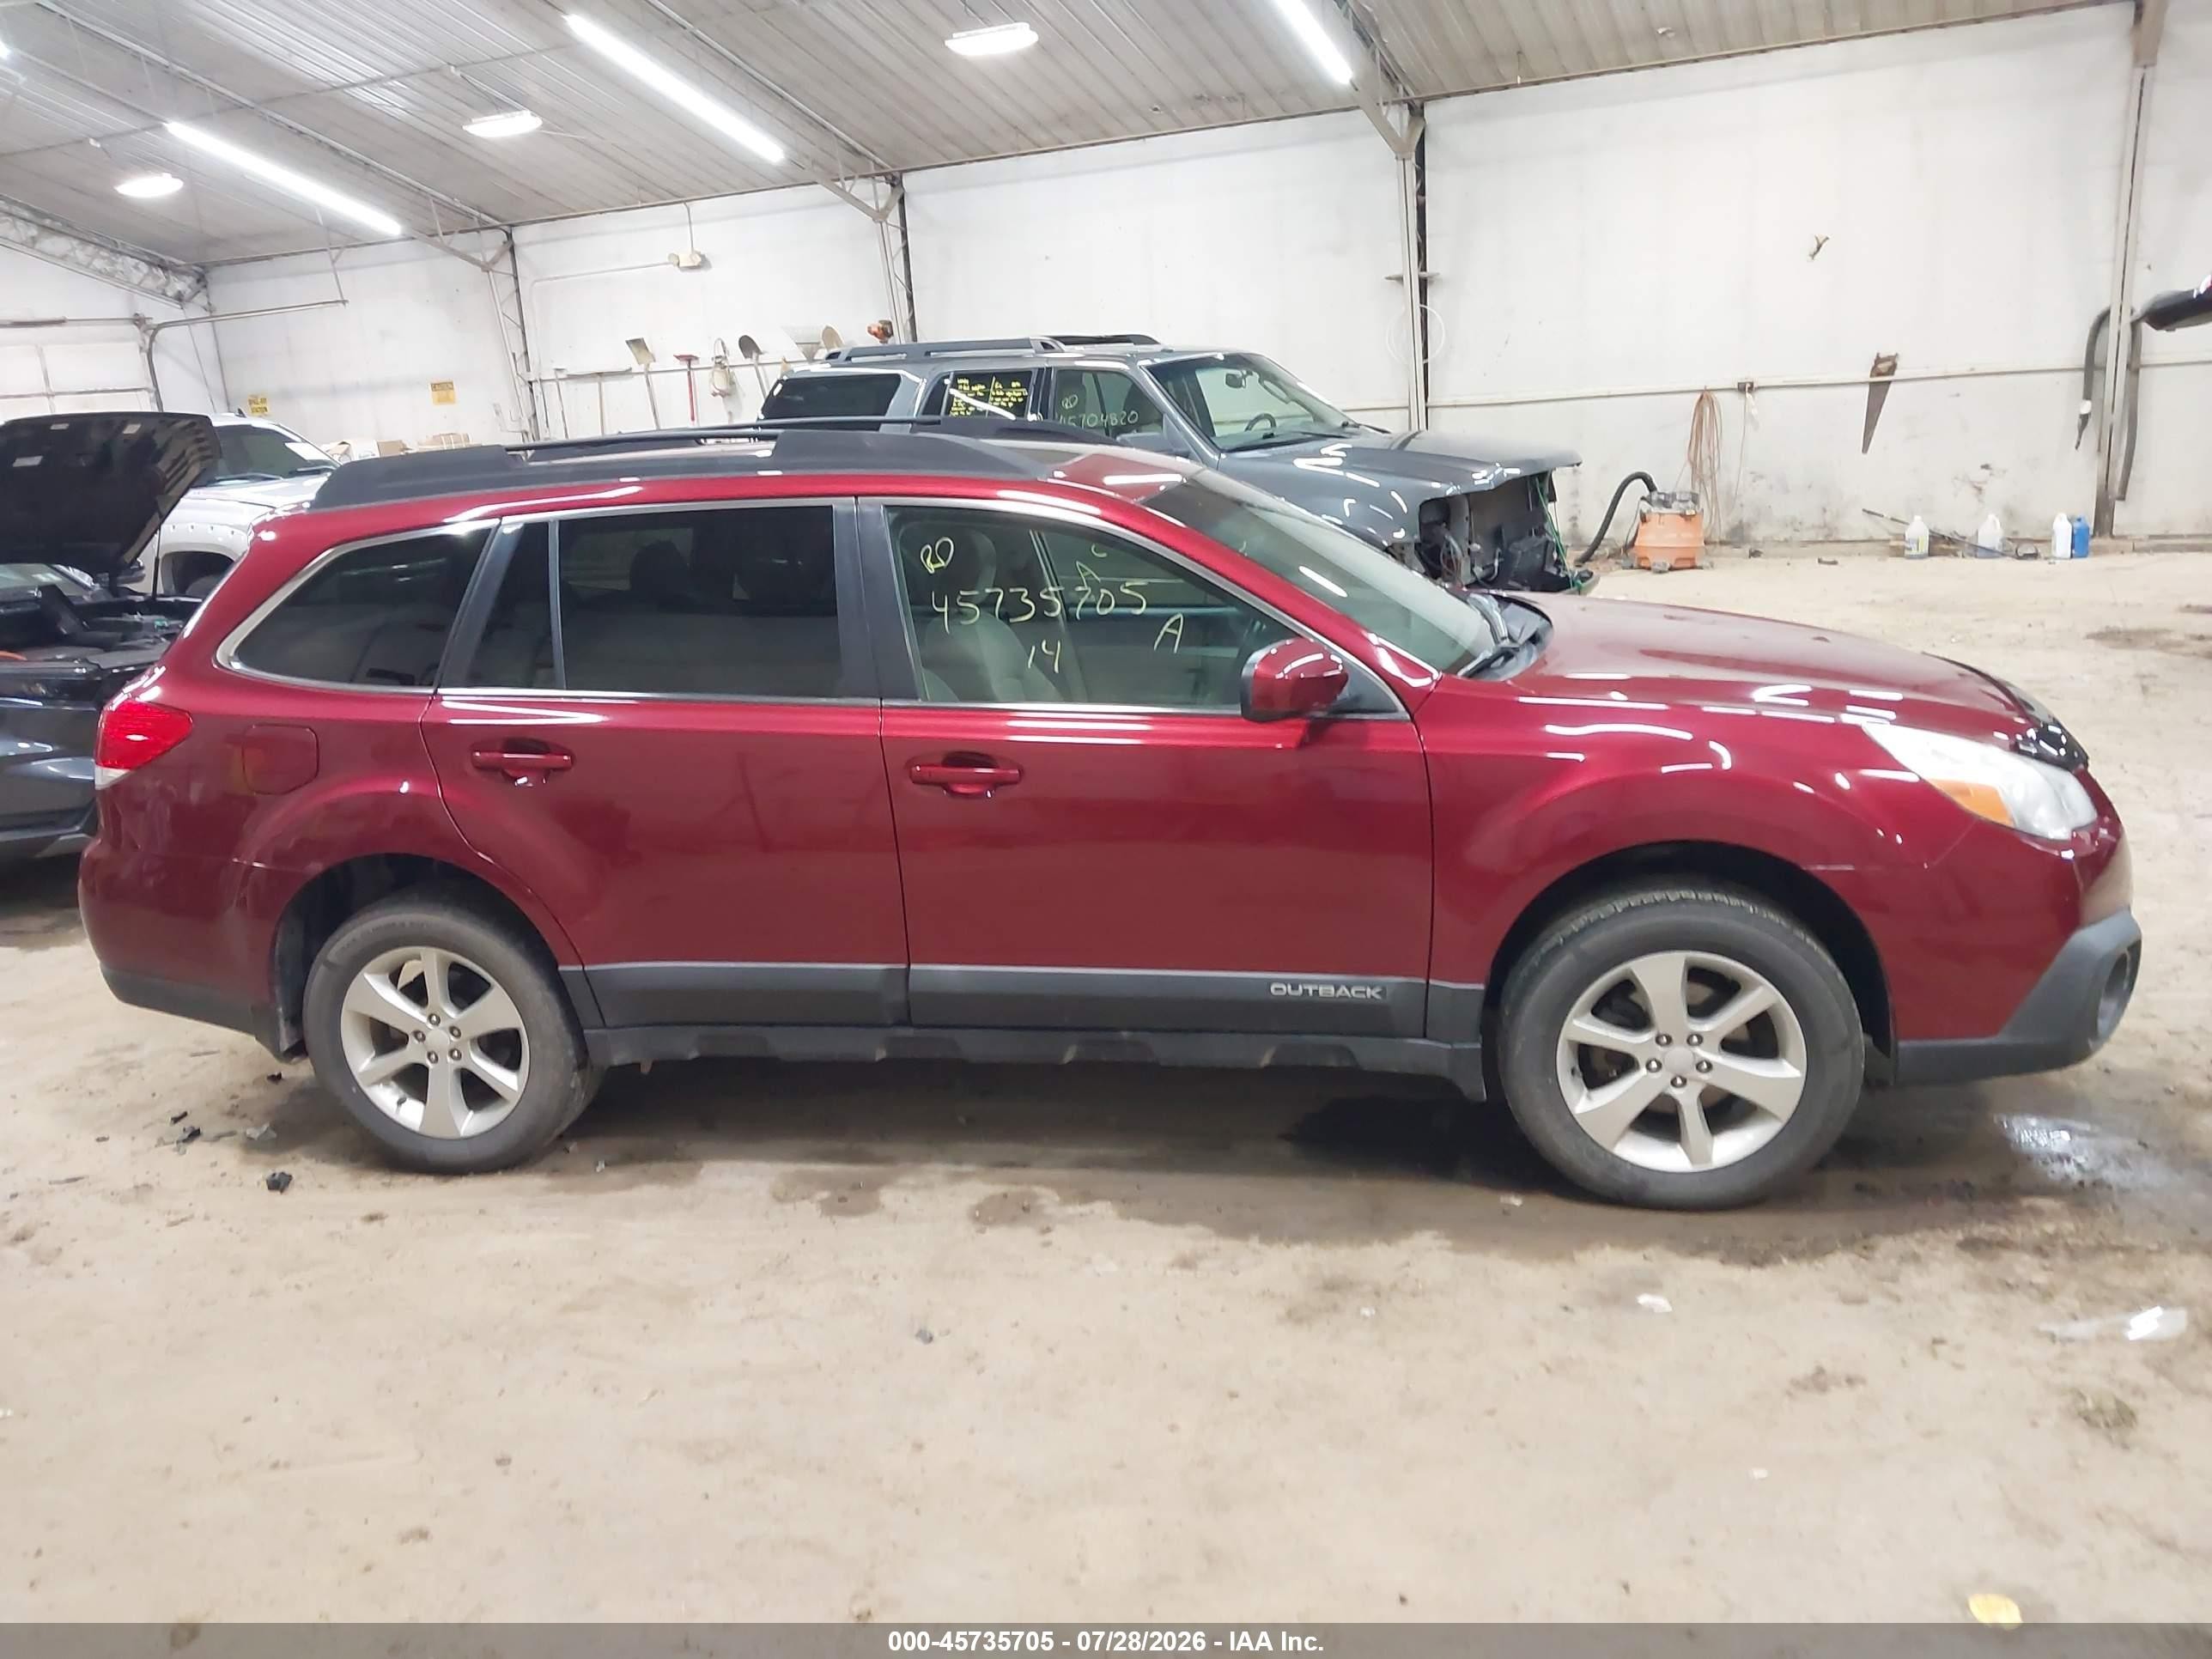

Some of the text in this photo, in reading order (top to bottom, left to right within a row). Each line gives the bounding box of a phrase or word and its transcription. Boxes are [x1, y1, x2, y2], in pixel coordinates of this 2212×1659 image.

[932, 581, 1148, 634] 45735705
[1153, 612, 1184, 653] A
[1027, 640, 1061, 673] 14
[1270, 981, 1382, 1000] OUTBACK
